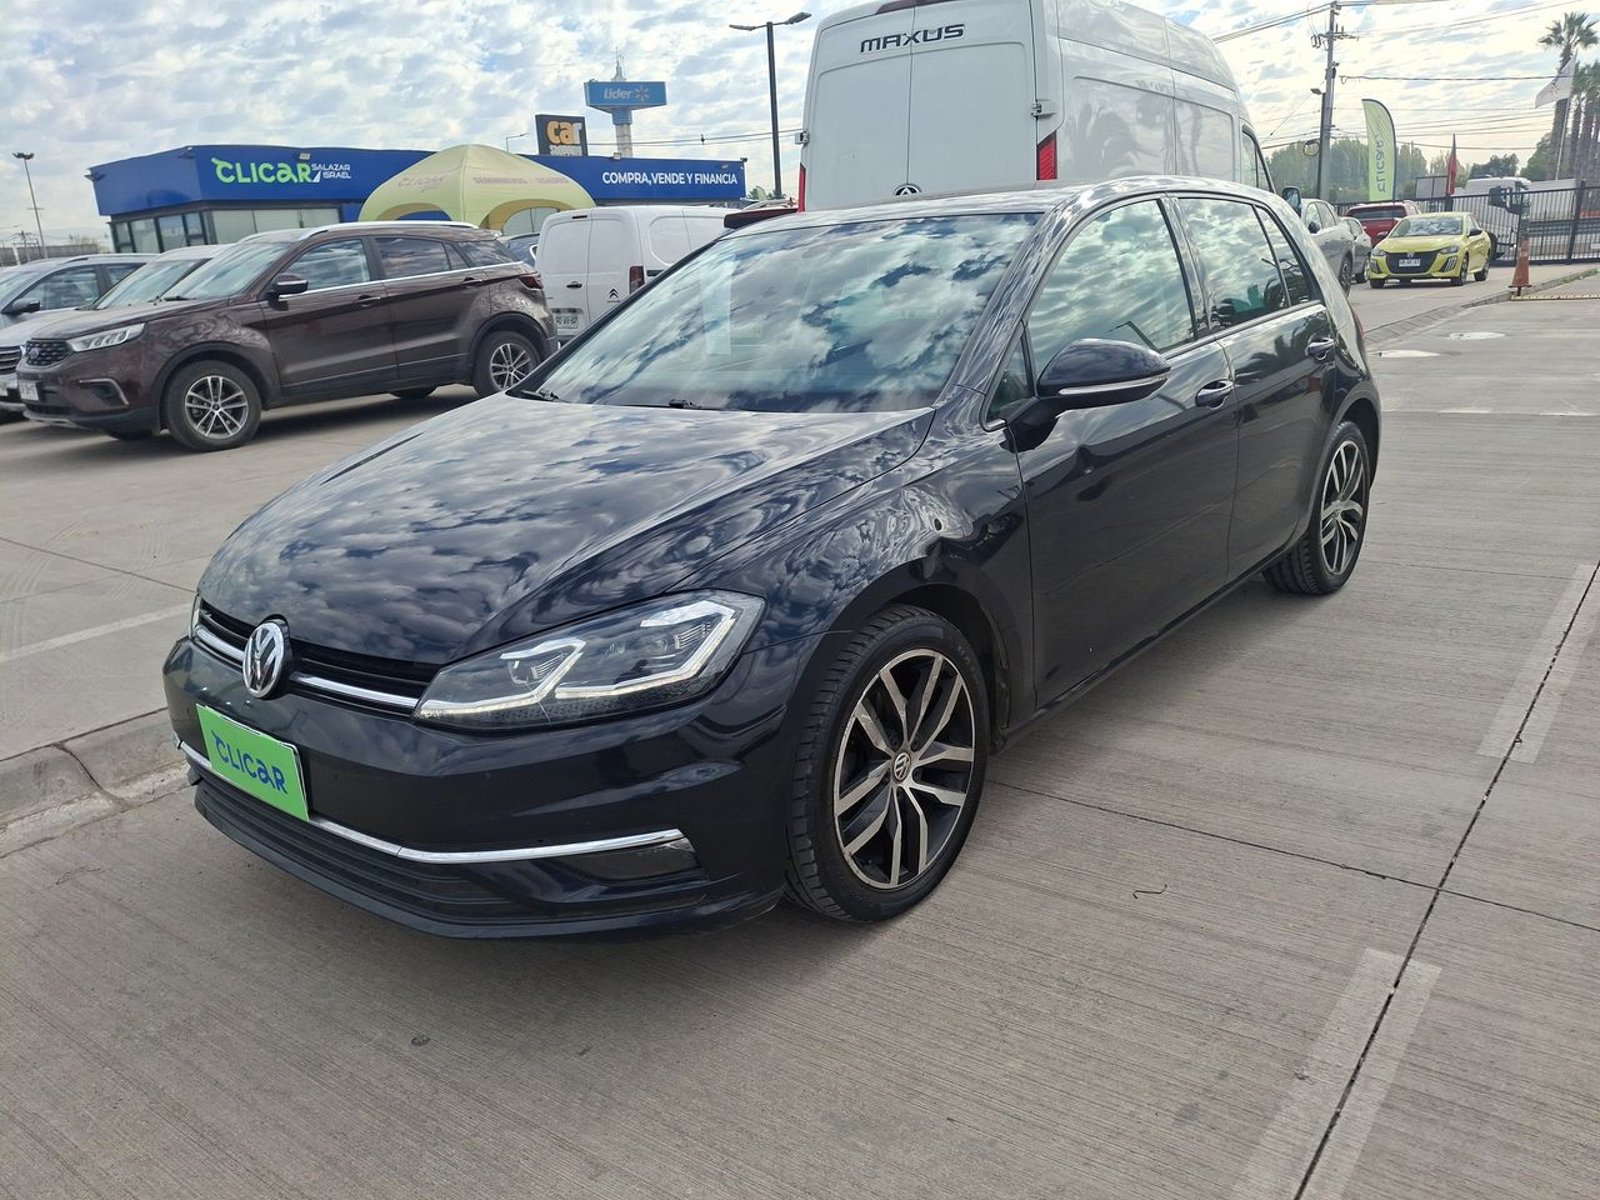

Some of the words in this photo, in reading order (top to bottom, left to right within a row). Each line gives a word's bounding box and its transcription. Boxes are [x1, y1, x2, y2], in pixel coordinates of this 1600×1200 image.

[860, 24, 965, 53] MAXUS
[547, 121, 582, 144] car
[322, 171, 352, 179] ISRAEL
[686, 173, 694, 184] Y
[694, 173, 739, 185] FINANCIA
